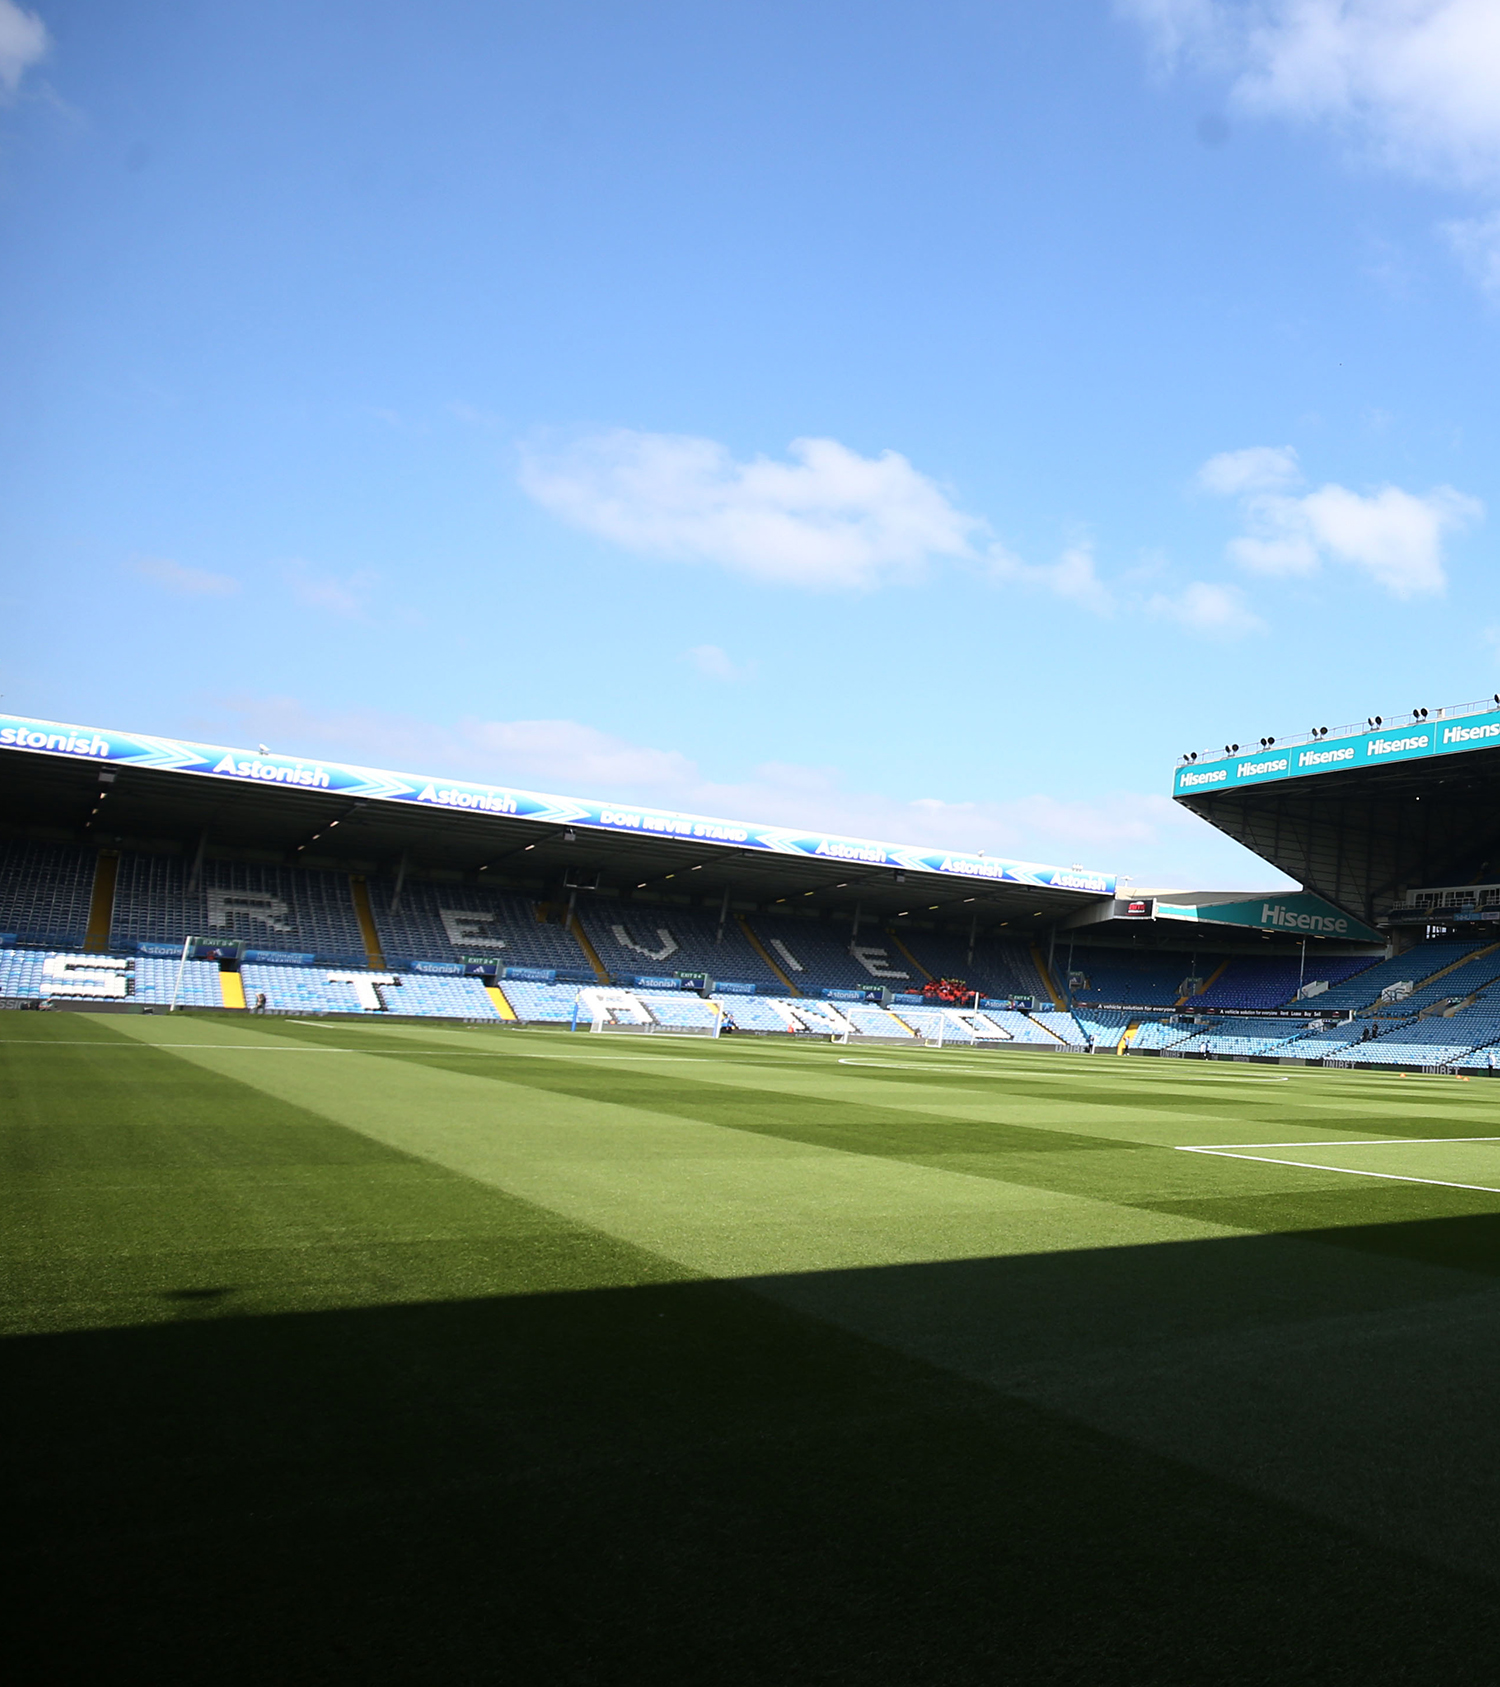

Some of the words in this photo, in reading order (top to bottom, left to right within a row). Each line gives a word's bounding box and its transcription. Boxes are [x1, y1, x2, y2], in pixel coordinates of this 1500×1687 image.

[1367, 735, 1429, 756] Hisense
[1298, 746, 1355, 767] Hisense
[212, 754, 331, 788] Astonish
[1179, 769, 1228, 788] Hisense
[1236, 758, 1288, 778] Hisense
[416, 783, 518, 813] Astonish
[600, 810, 641, 828] DON
[642, 816, 693, 835] REVIE
[693, 823, 748, 842] STAND
[815, 839, 888, 864] Astonish
[939, 856, 1004, 878] Astonish
[1050, 871, 1107, 892] Astonish
[1261, 903, 1348, 933] Hisense
[415, 963, 461, 974] Astonish
[638, 978, 677, 988] Astonish
[827, 990, 860, 999] Astonish
[1055, 1044, 1087, 1054] UNIBE
